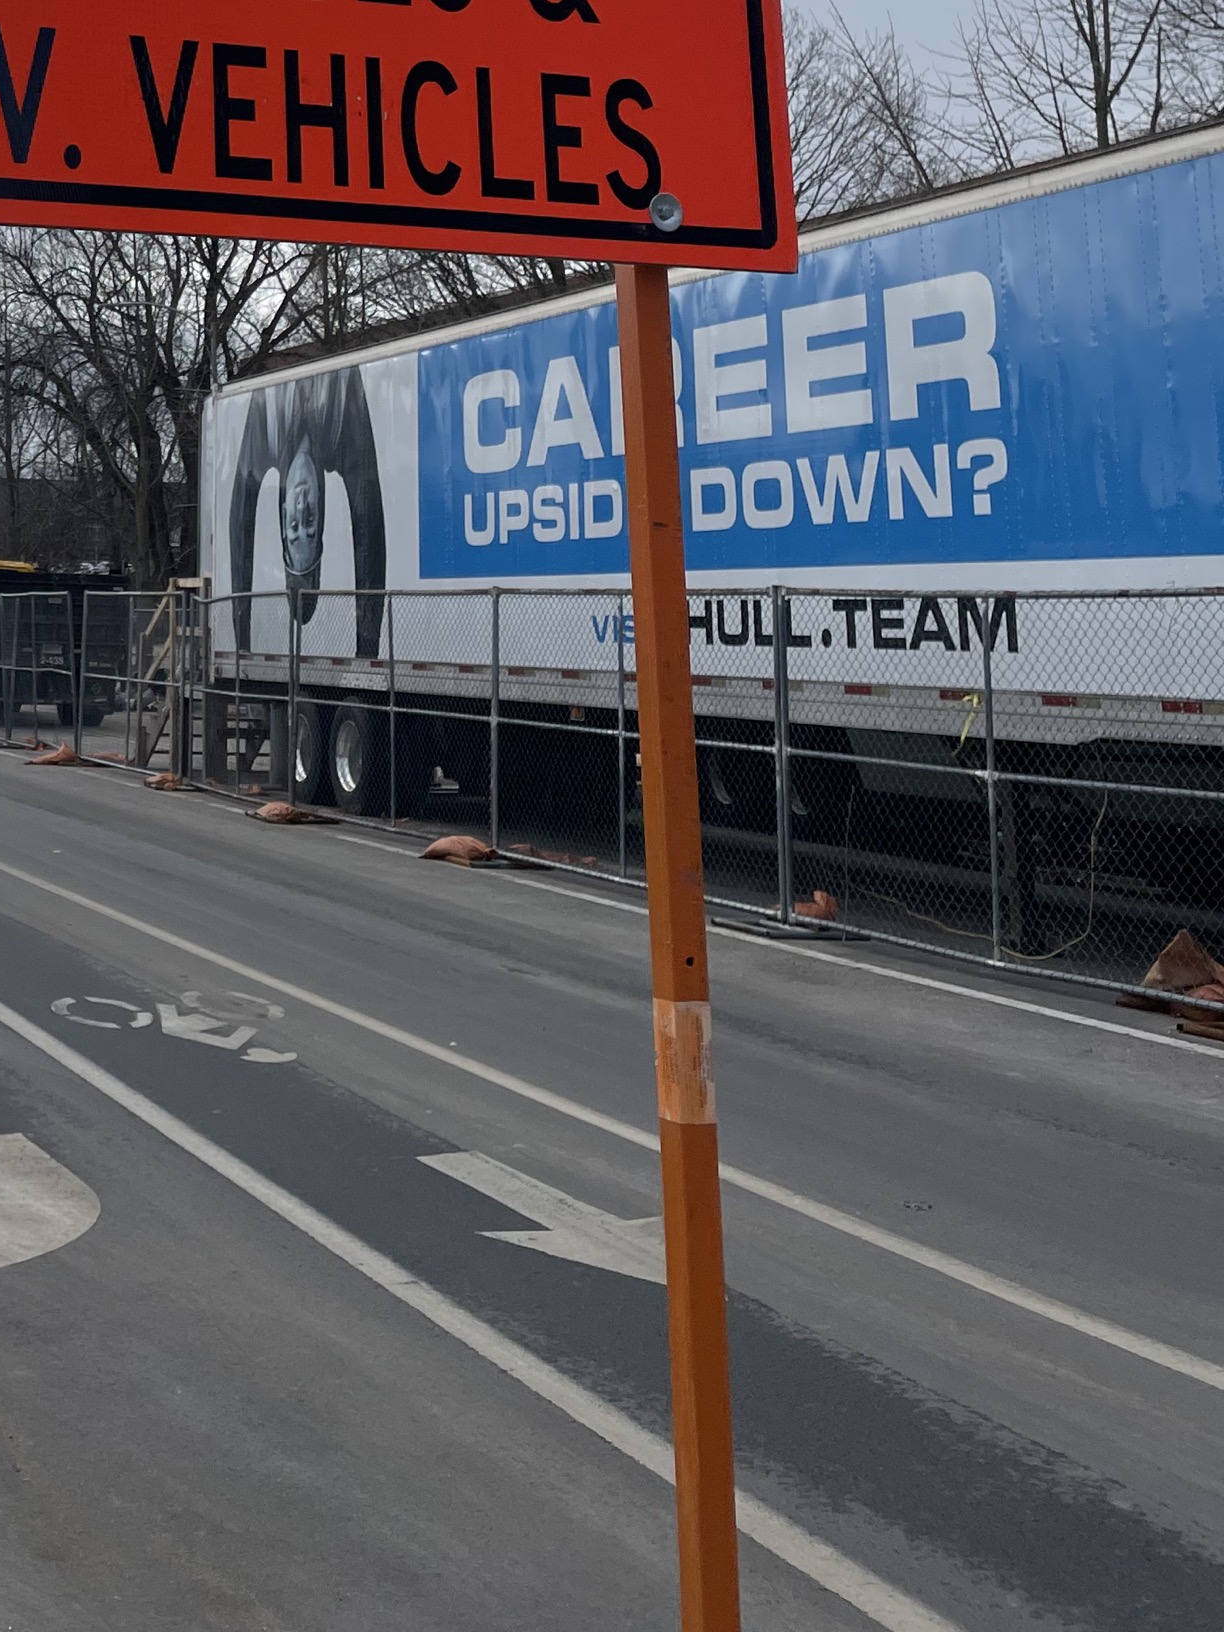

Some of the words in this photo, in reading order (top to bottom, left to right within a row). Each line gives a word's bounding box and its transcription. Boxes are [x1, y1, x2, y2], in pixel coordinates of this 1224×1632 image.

[129, 34, 663, 211] VEHICLES
[464, 479, 623, 547] UPSID
[690, 438, 1009, 533] DOWN?
